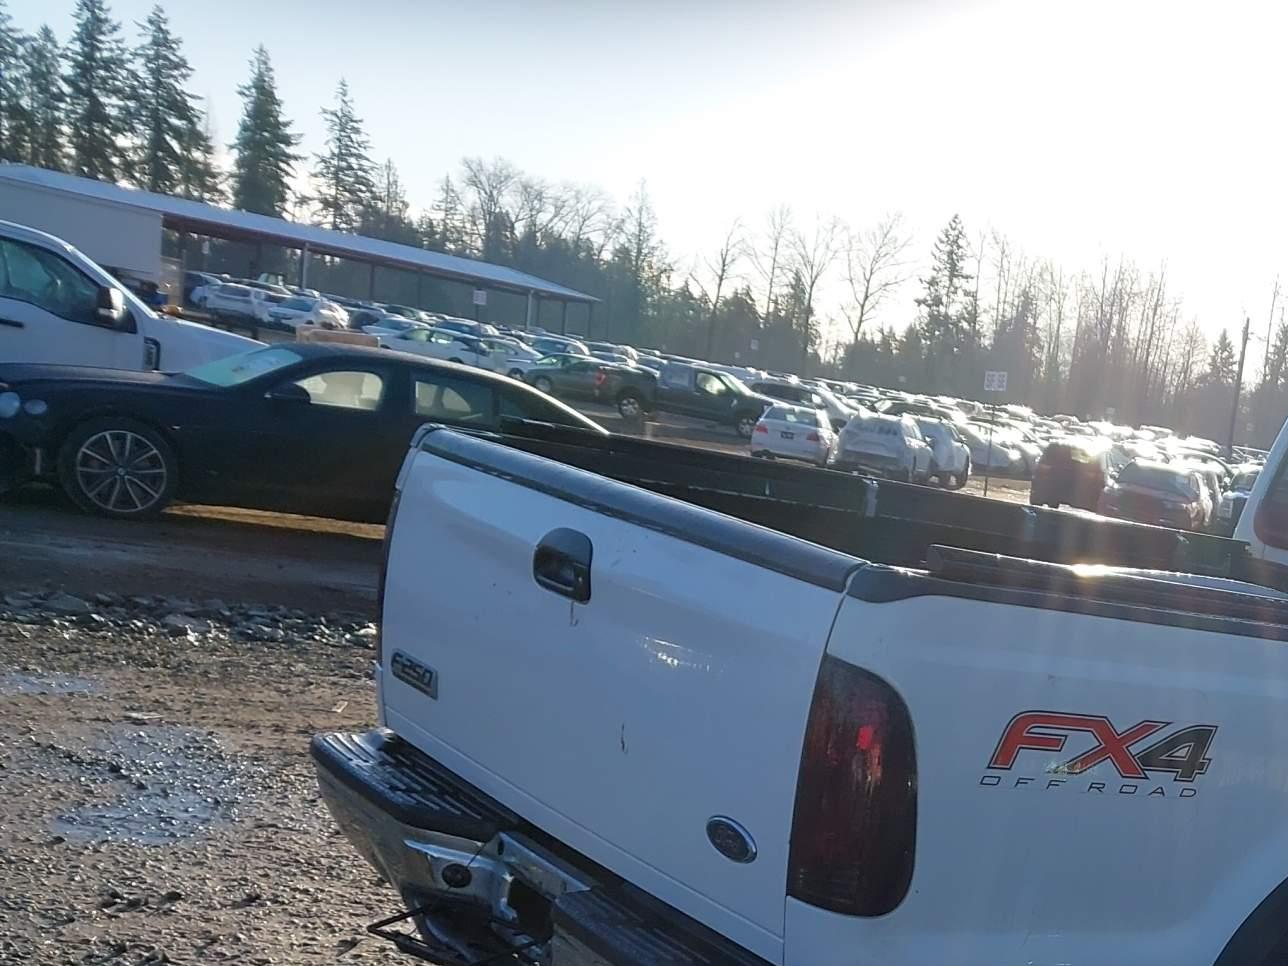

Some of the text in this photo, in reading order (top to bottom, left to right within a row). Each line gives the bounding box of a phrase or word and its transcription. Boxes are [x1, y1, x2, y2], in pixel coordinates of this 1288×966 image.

[987, 710, 1218, 782] FX4
[980, 775, 1197, 798] OFF ROAD
